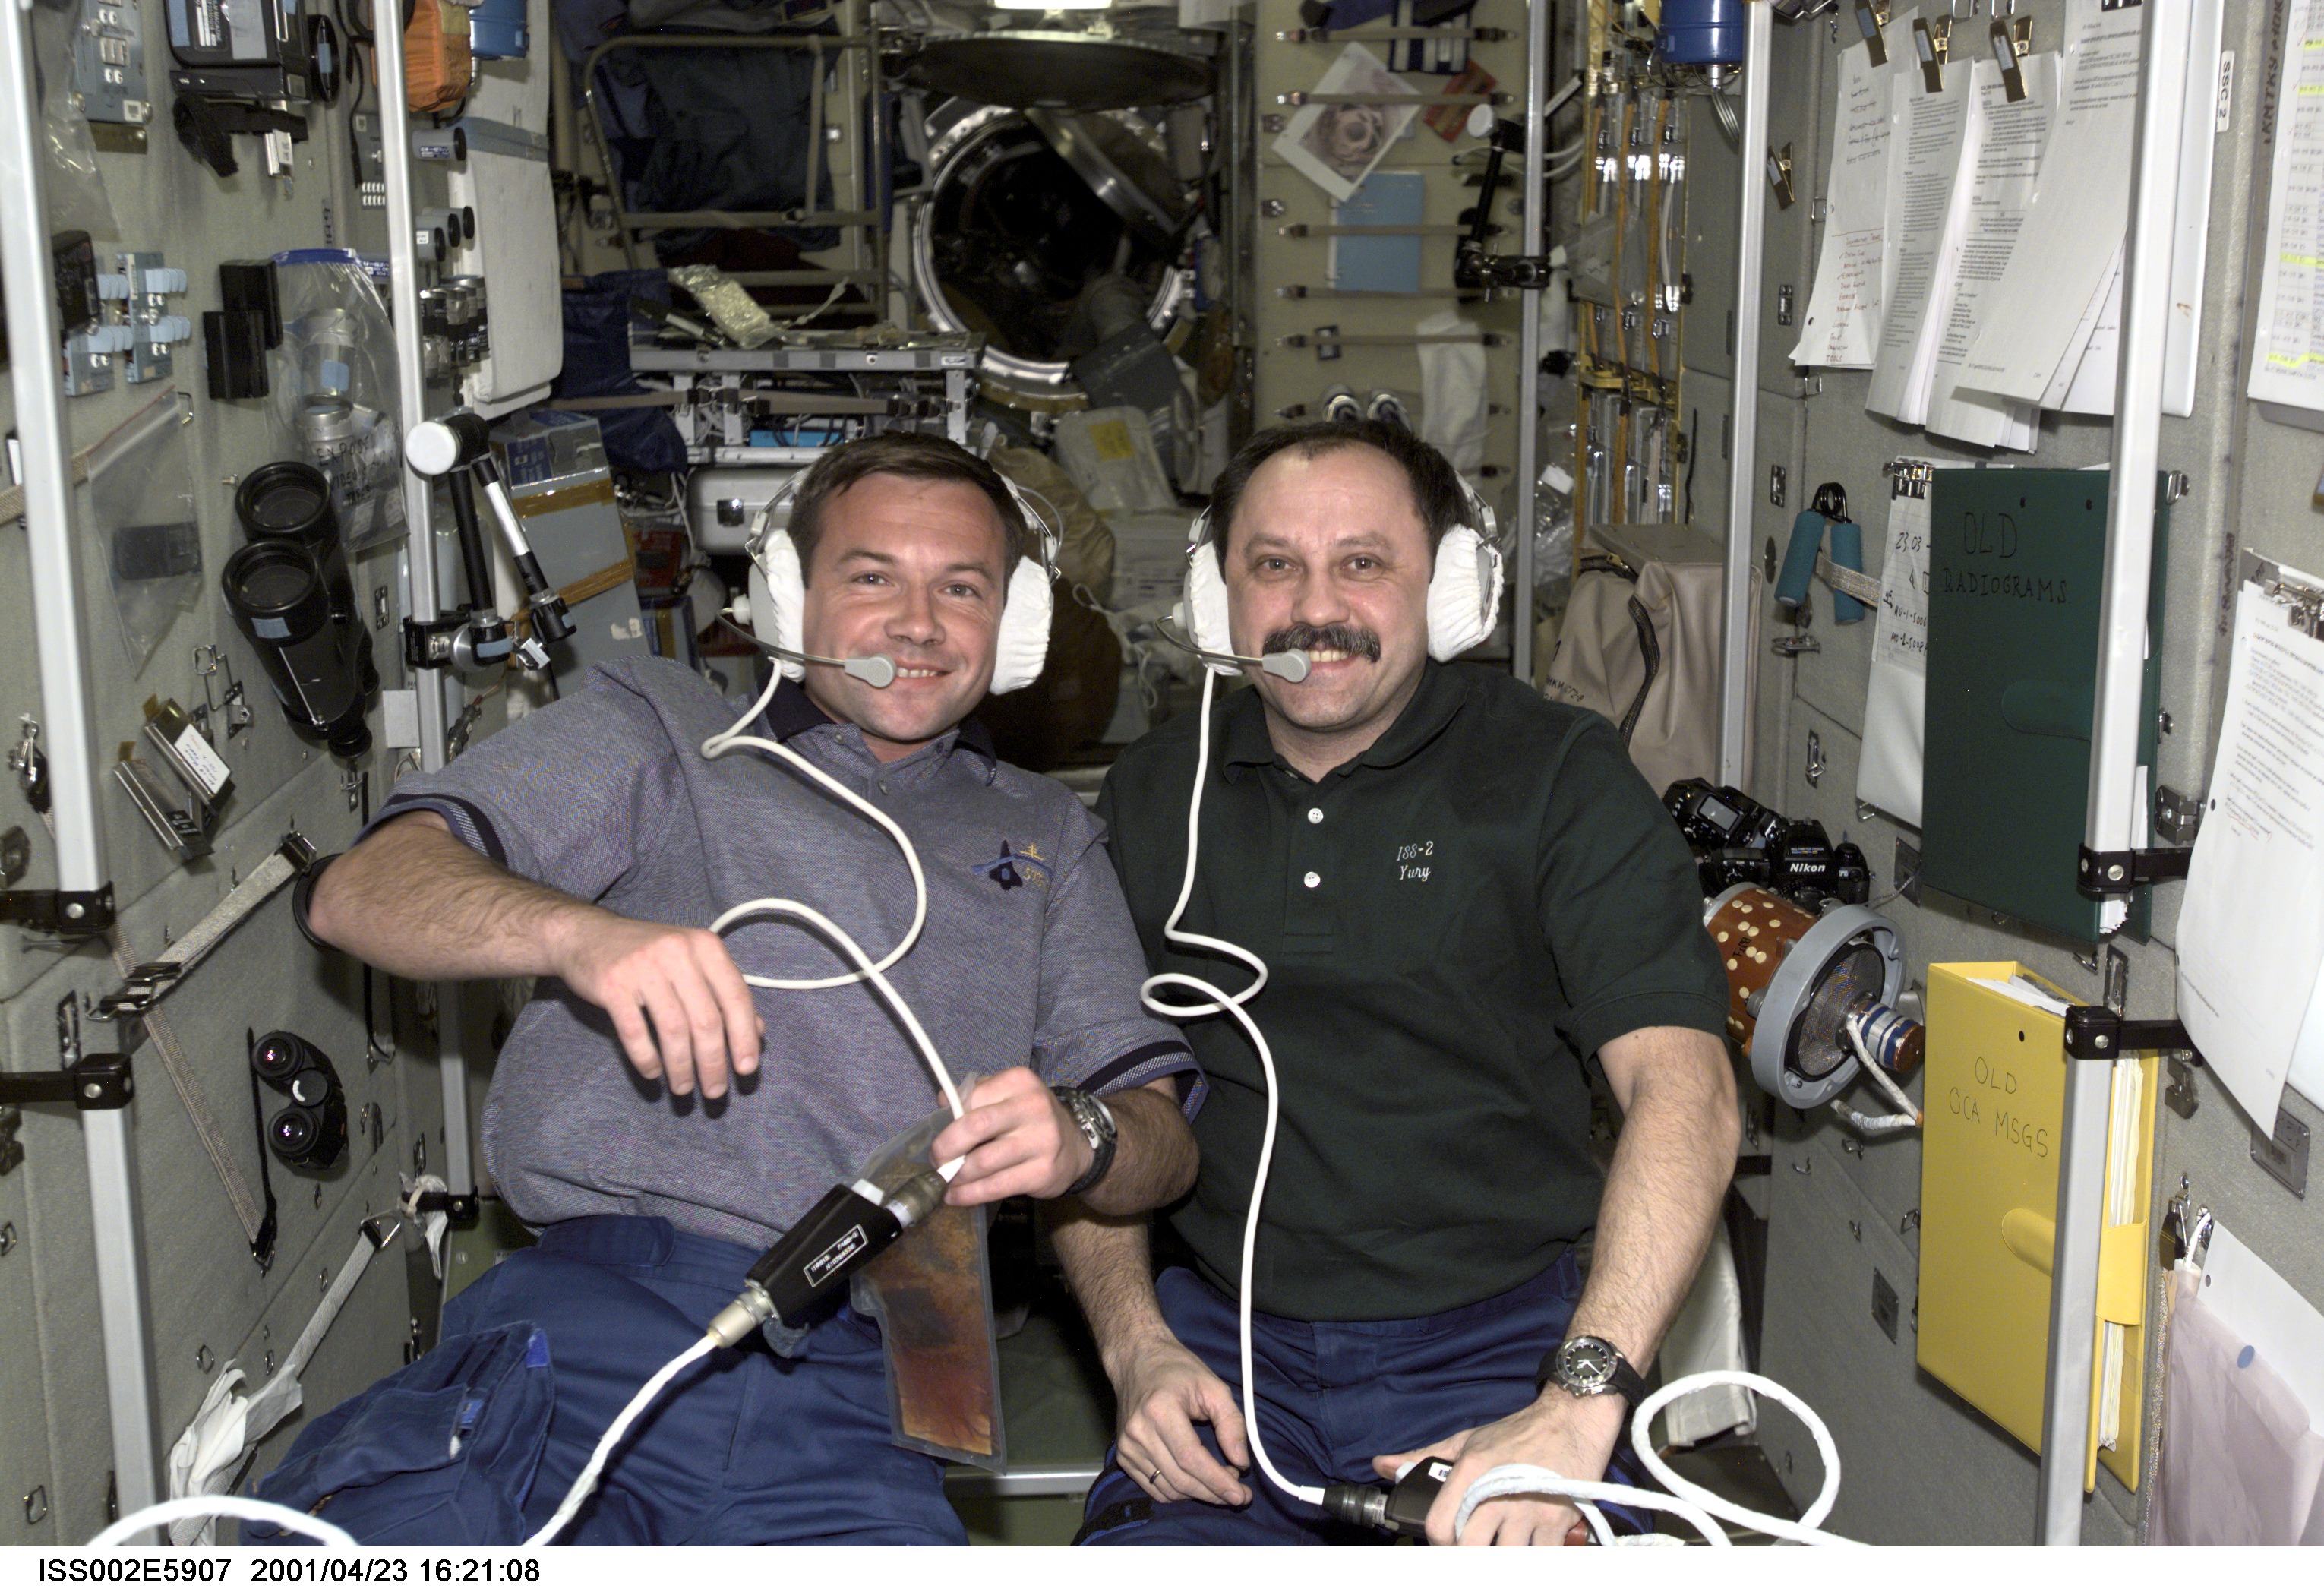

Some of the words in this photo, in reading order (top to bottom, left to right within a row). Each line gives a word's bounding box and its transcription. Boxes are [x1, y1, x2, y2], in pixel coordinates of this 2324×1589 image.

[2220, 61, 2231, 101] SSC
[2218, 110, 2226, 118] 2
[1896, 532, 1922, 553] 23.03
[1963, 511, 2018, 558] OLD
[1396, 841, 1434, 861] ISS-2
[1399, 864, 1432, 882] Yury
[1789, 862, 1826, 873] Nikon
[1975, 1057, 2016, 1095] OLD
[1949, 1087, 1981, 1123] OCA
[1995, 1109, 2048, 1158] MSGS
